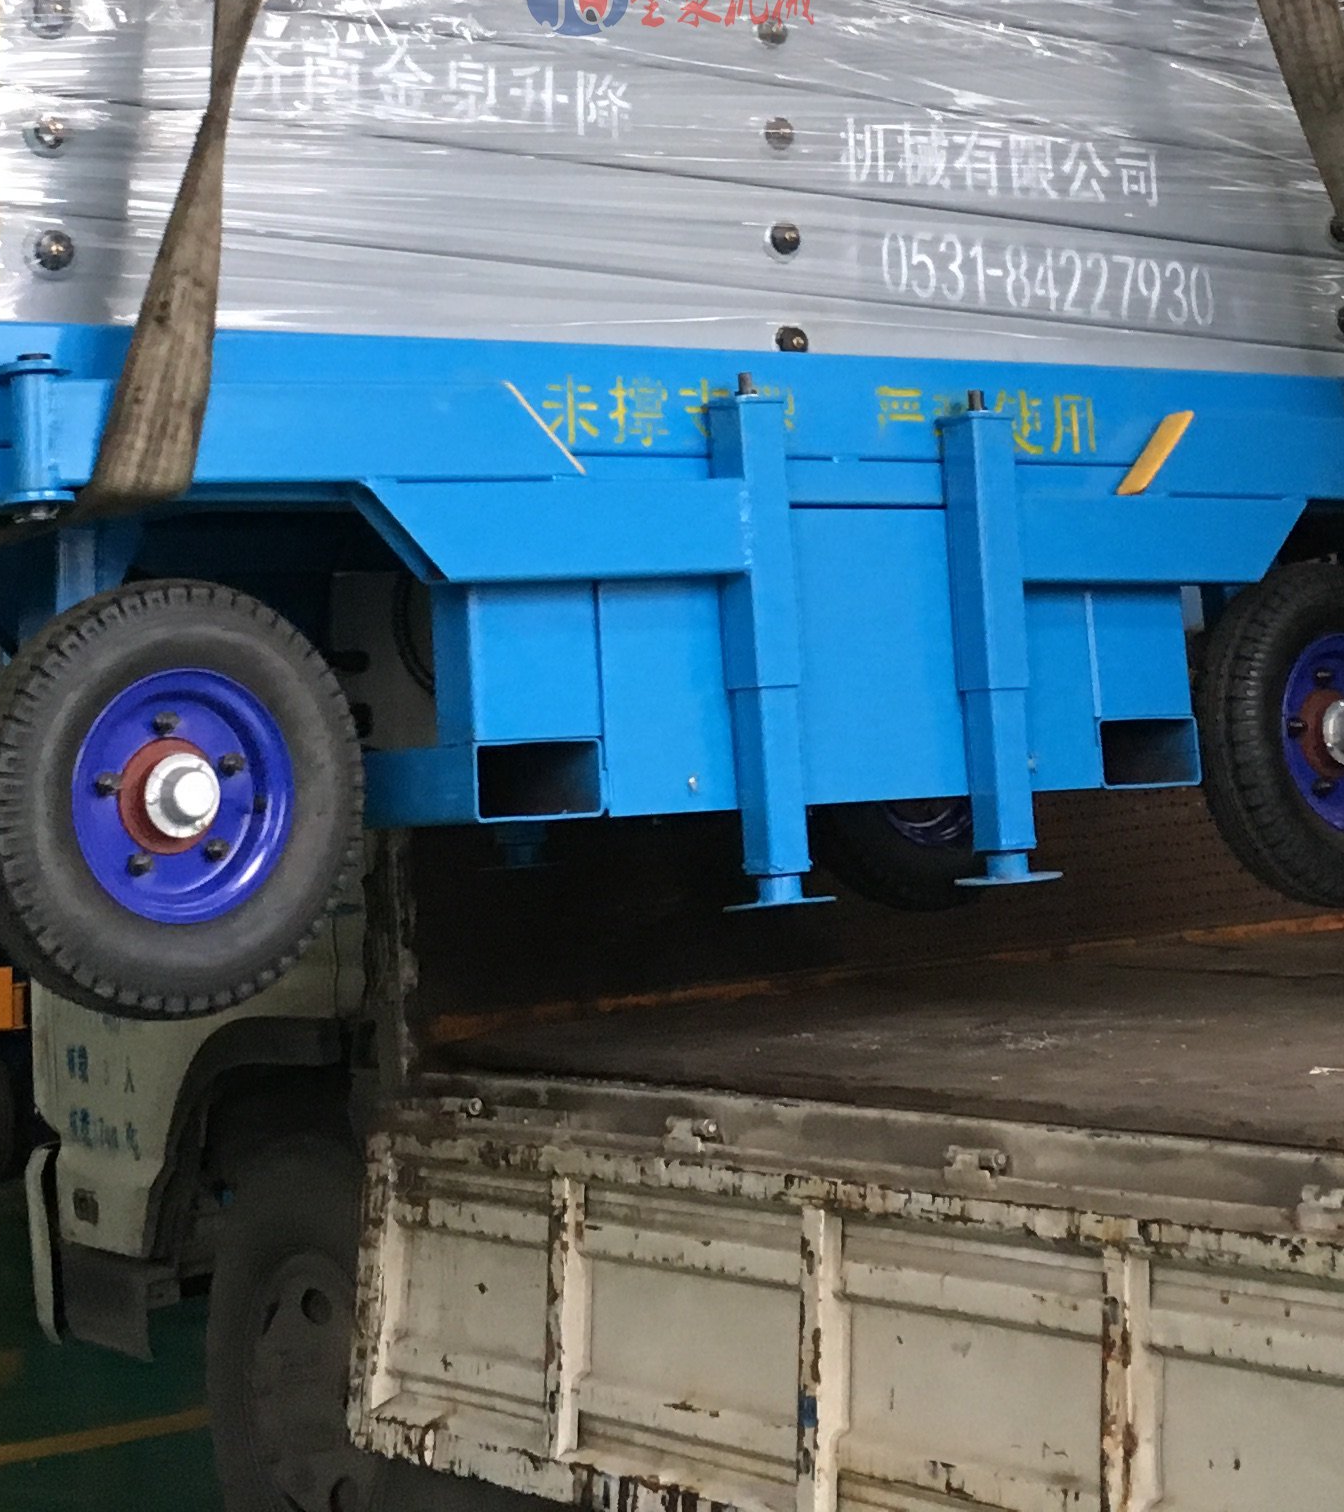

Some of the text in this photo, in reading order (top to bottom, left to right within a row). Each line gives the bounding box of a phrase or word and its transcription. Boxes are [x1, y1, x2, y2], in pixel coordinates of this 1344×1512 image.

[840, 118, 1158, 207] 机械有限公司
[881, 231, 1215, 325] 0531-84227930
